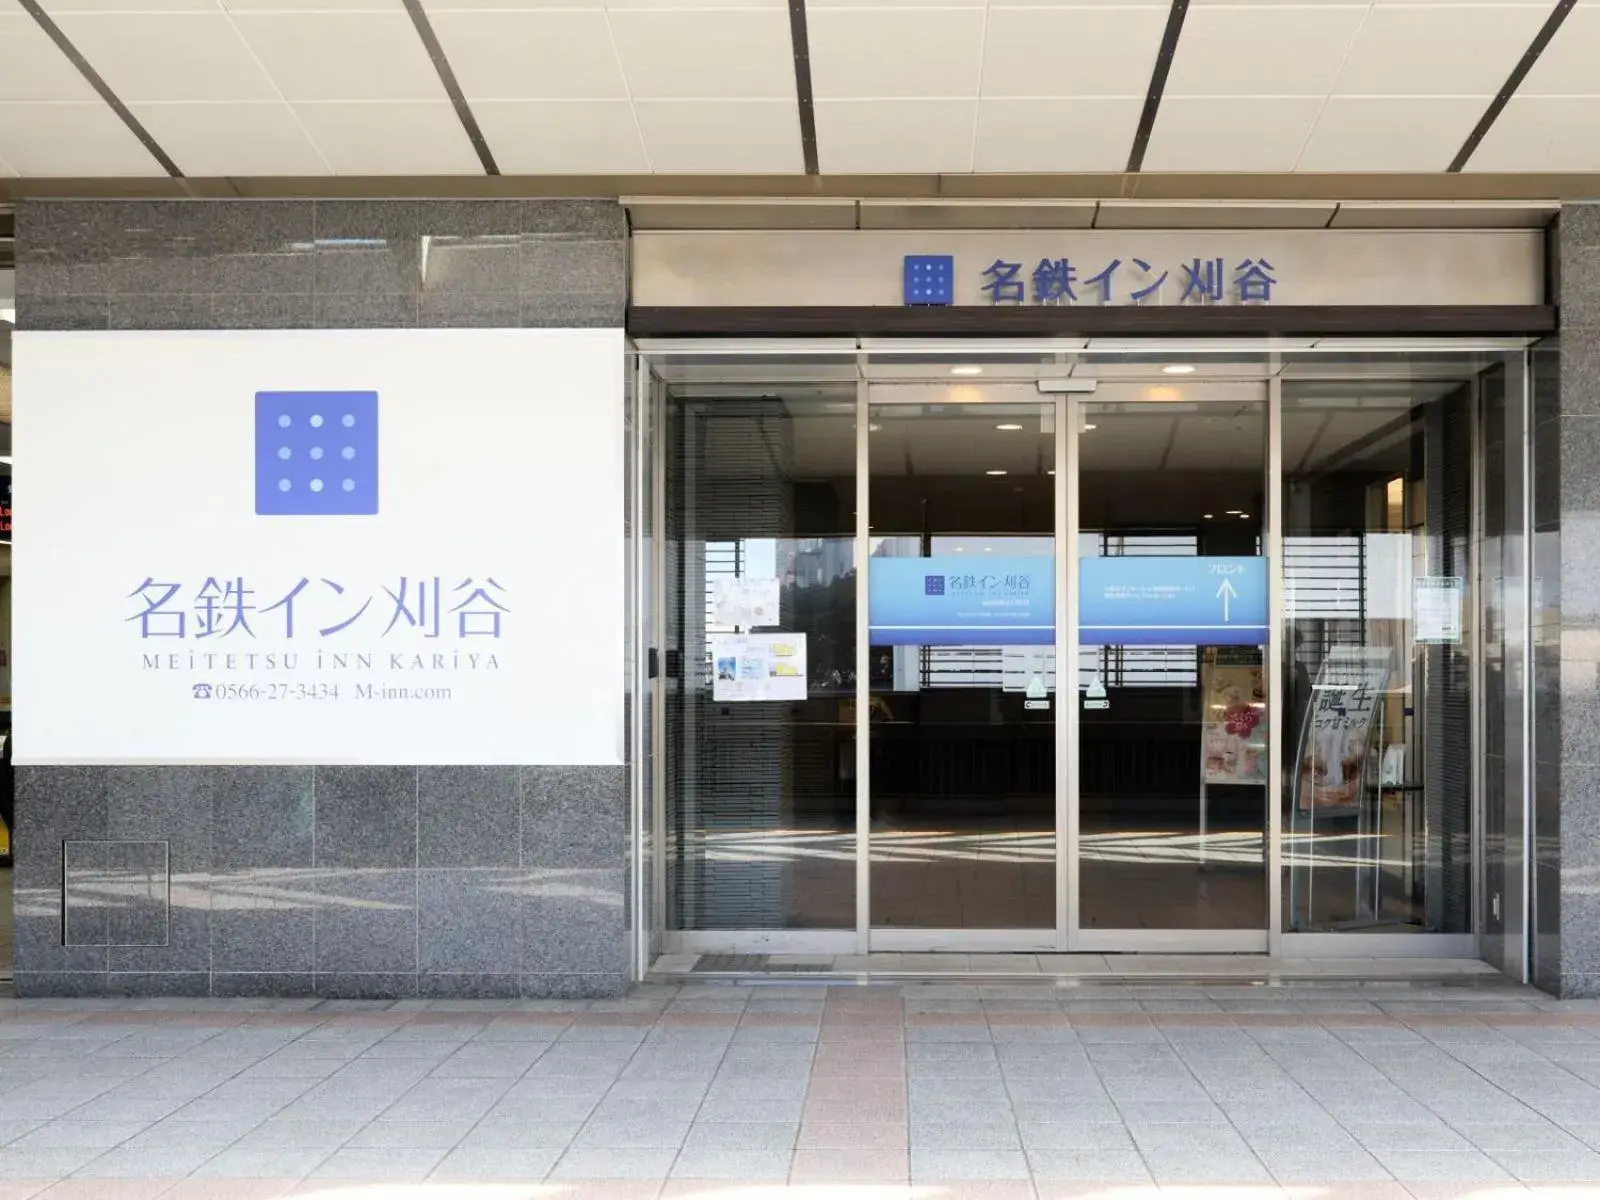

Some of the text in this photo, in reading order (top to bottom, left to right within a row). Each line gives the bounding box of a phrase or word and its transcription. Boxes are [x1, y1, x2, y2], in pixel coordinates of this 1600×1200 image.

[982, 258, 1277, 302] 名鉄イン刈谷
[1208, 563, 1245, 575] フロント
[949, 575, 1031, 590] 名鉄イン刈谷
[125, 576, 510, 638] 名鉄イン刈谷
[215, 683, 452, 700] 0566-27-3434 M-inn.com
